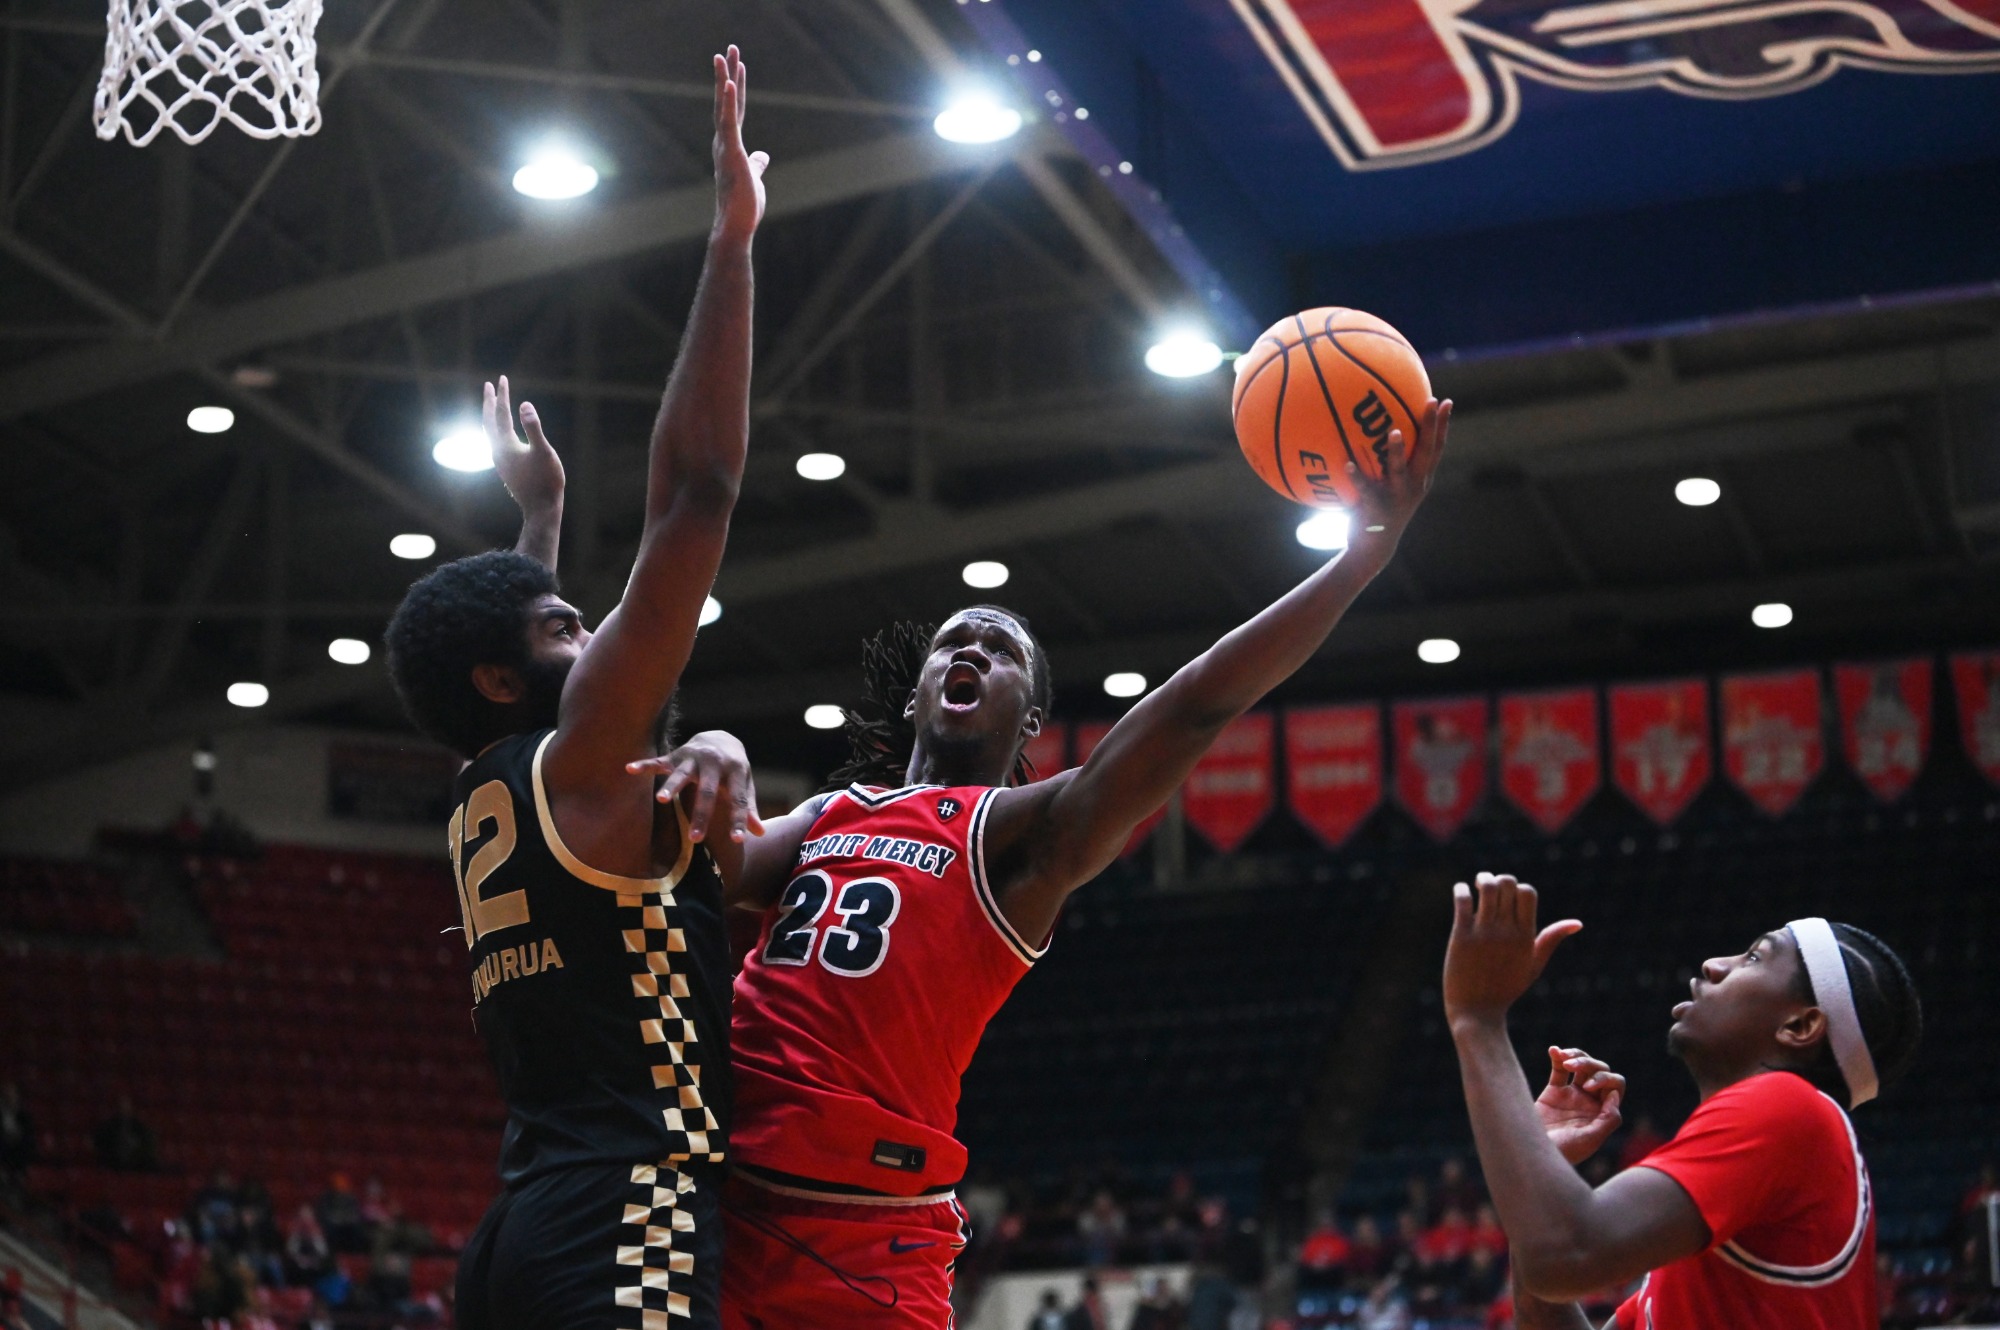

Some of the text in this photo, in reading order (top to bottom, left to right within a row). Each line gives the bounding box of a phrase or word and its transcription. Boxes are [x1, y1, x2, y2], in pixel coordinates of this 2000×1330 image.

[448, 780, 530, 951] 12
[863, 835, 956, 878] MERCY
[762, 869, 901, 978] 23
